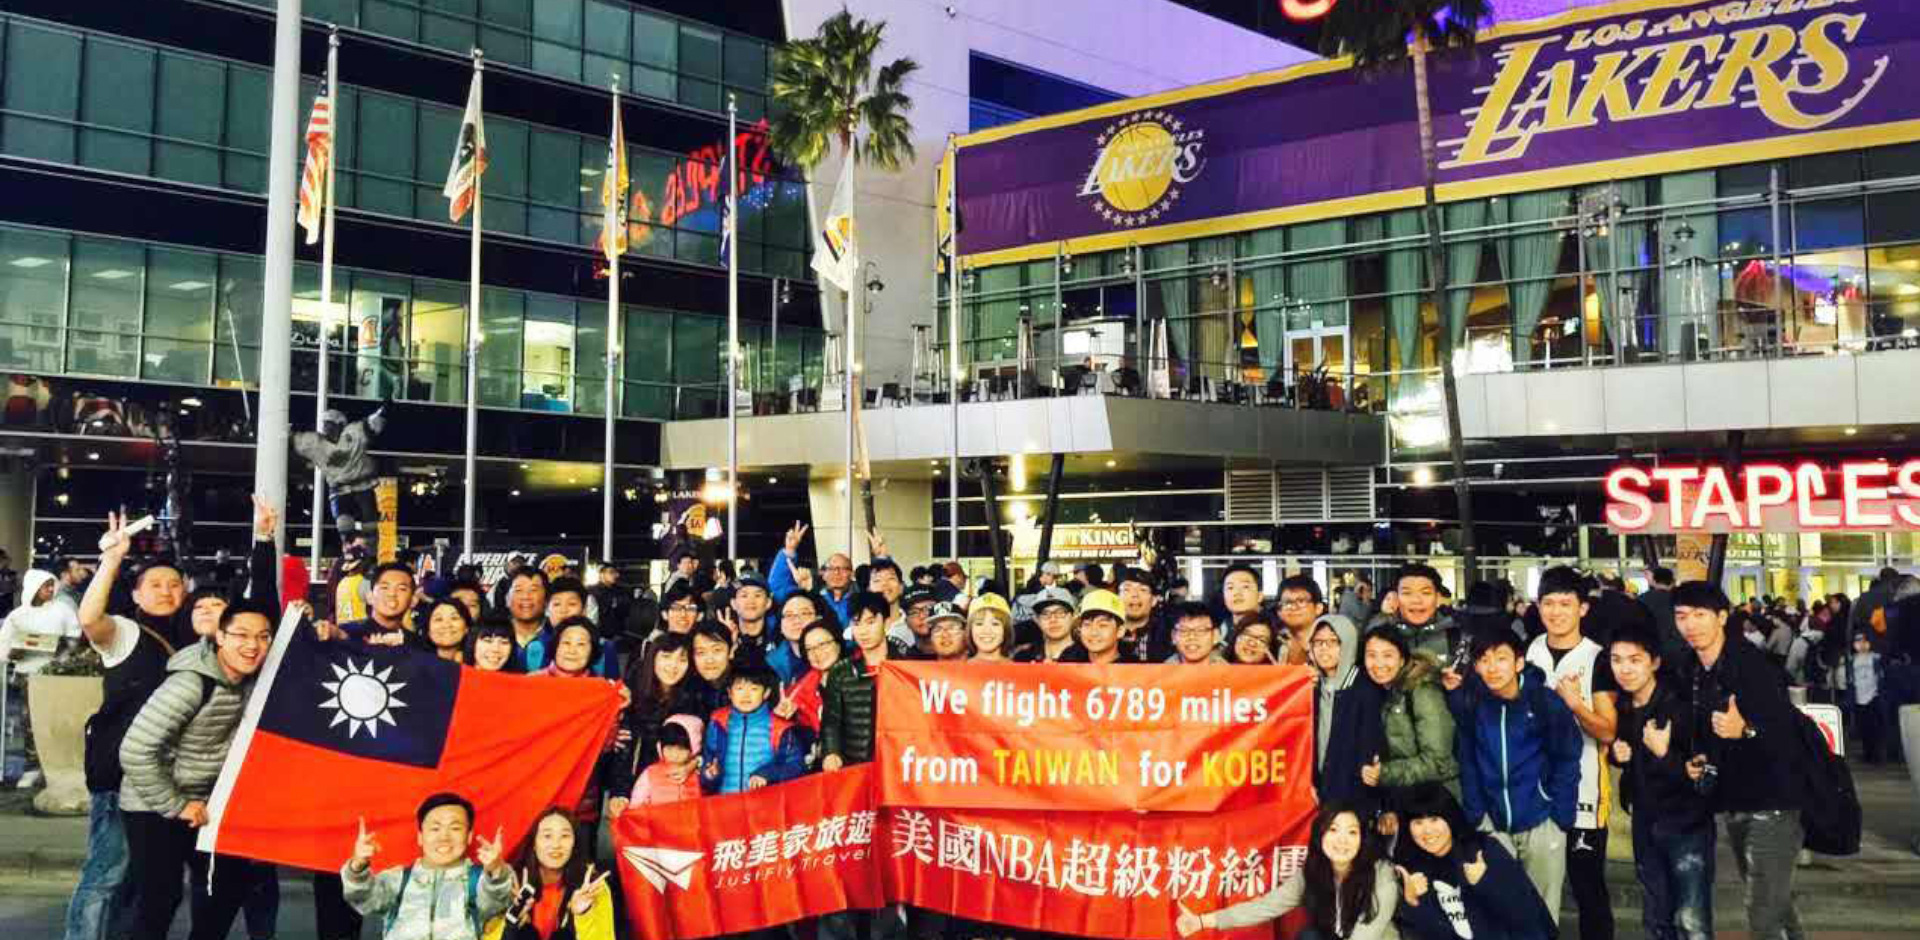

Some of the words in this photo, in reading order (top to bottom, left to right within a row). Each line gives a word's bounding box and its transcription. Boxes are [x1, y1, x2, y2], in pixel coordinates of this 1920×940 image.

[1566, 20, 1647, 50] LOS
[1648, 0, 1858, 37] ANGEL
[1437, 12, 1890, 169] LAKERS
[1076, 142, 1207, 197] LAKERS
[1605, 461, 1920, 529] STAPLES
[919, 679, 968, 716] We
[981, 680, 1071, 727] flight
[1086, 687, 1166, 721] 6789
[1181, 688, 1268, 723] miles
[901, 746, 978, 784] from
[993, 749, 1119, 786] TAIWAN
[1139, 751, 1187, 787] for
[1202, 749, 1286, 786] KOBE
[712, 810, 878, 873] 飛美家旅遊
